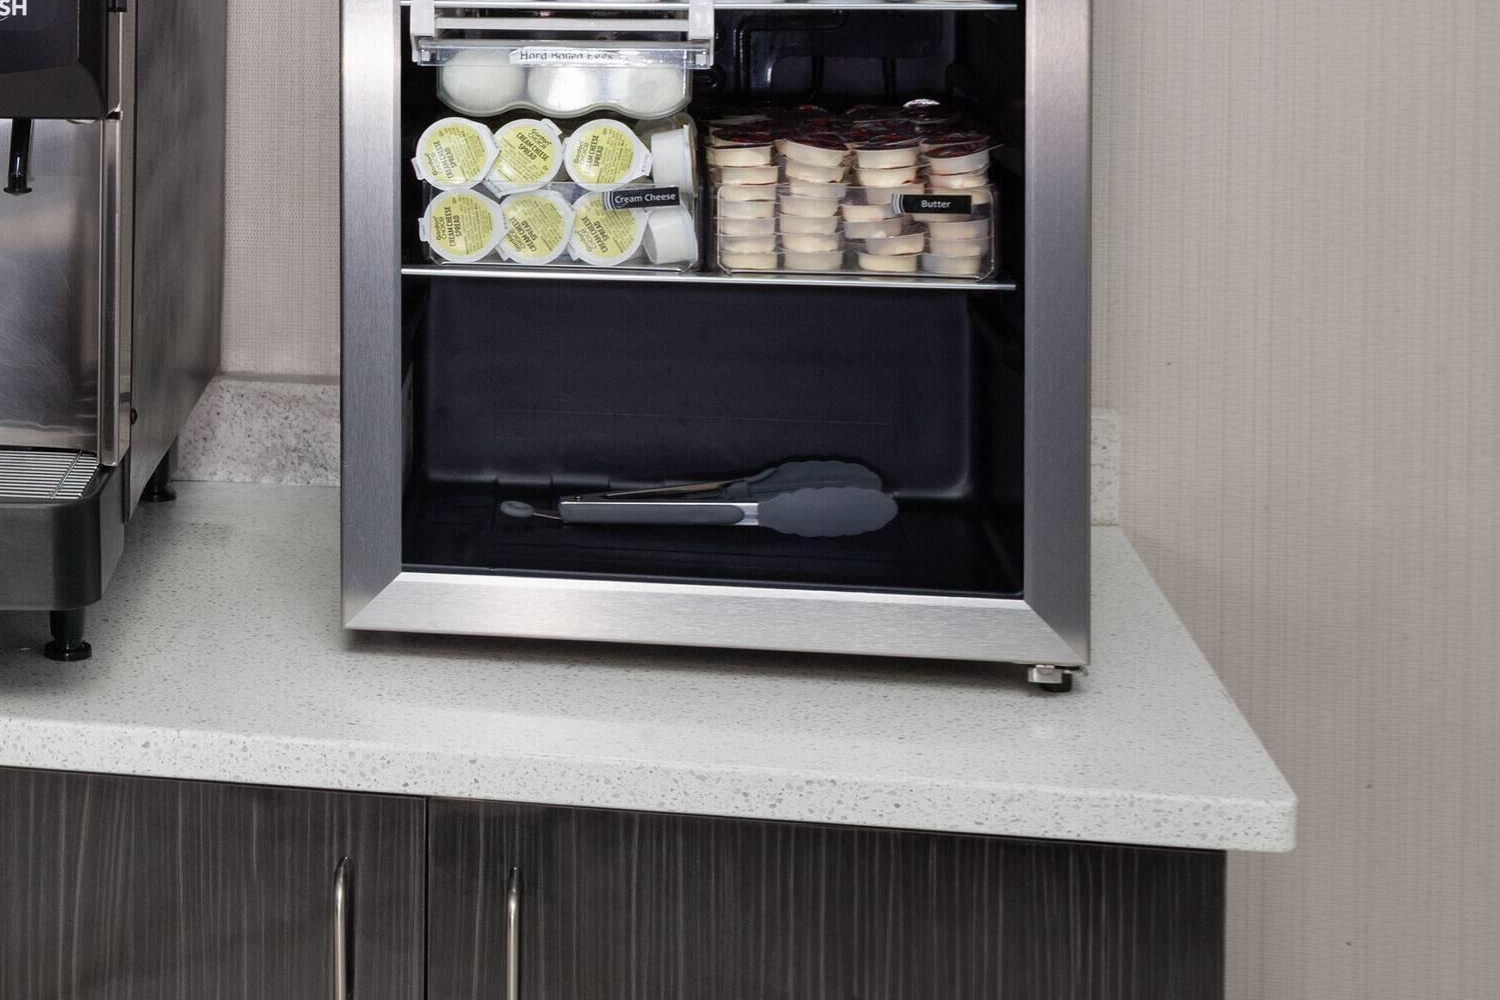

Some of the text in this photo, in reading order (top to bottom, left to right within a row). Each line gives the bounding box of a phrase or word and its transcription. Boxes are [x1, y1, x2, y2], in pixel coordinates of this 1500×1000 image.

[520, 50, 547, 60] Hard
[517, 132, 549, 161] CREAM CHEESE
[518, 143, 537, 160] SPREAD
[590, 135, 599, 154] CHEESE
[433, 140, 453, 179] CREAM CHEESE
[444, 147, 457, 168] SPREAD
[593, 146, 603, 167] SPREAD
[615, 193, 676, 204] Cream Cheese
[921, 200, 951, 208] Butter
[444, 206, 456, 247] CREAM CHEESE
[453, 215, 462, 237] SPREAD
[521, 220, 538, 241] SPREAD
[581, 216, 608, 253] CREAM CHEESE
[593, 220, 610, 241] SPREAD
[522, 235, 537, 252] CREAM
